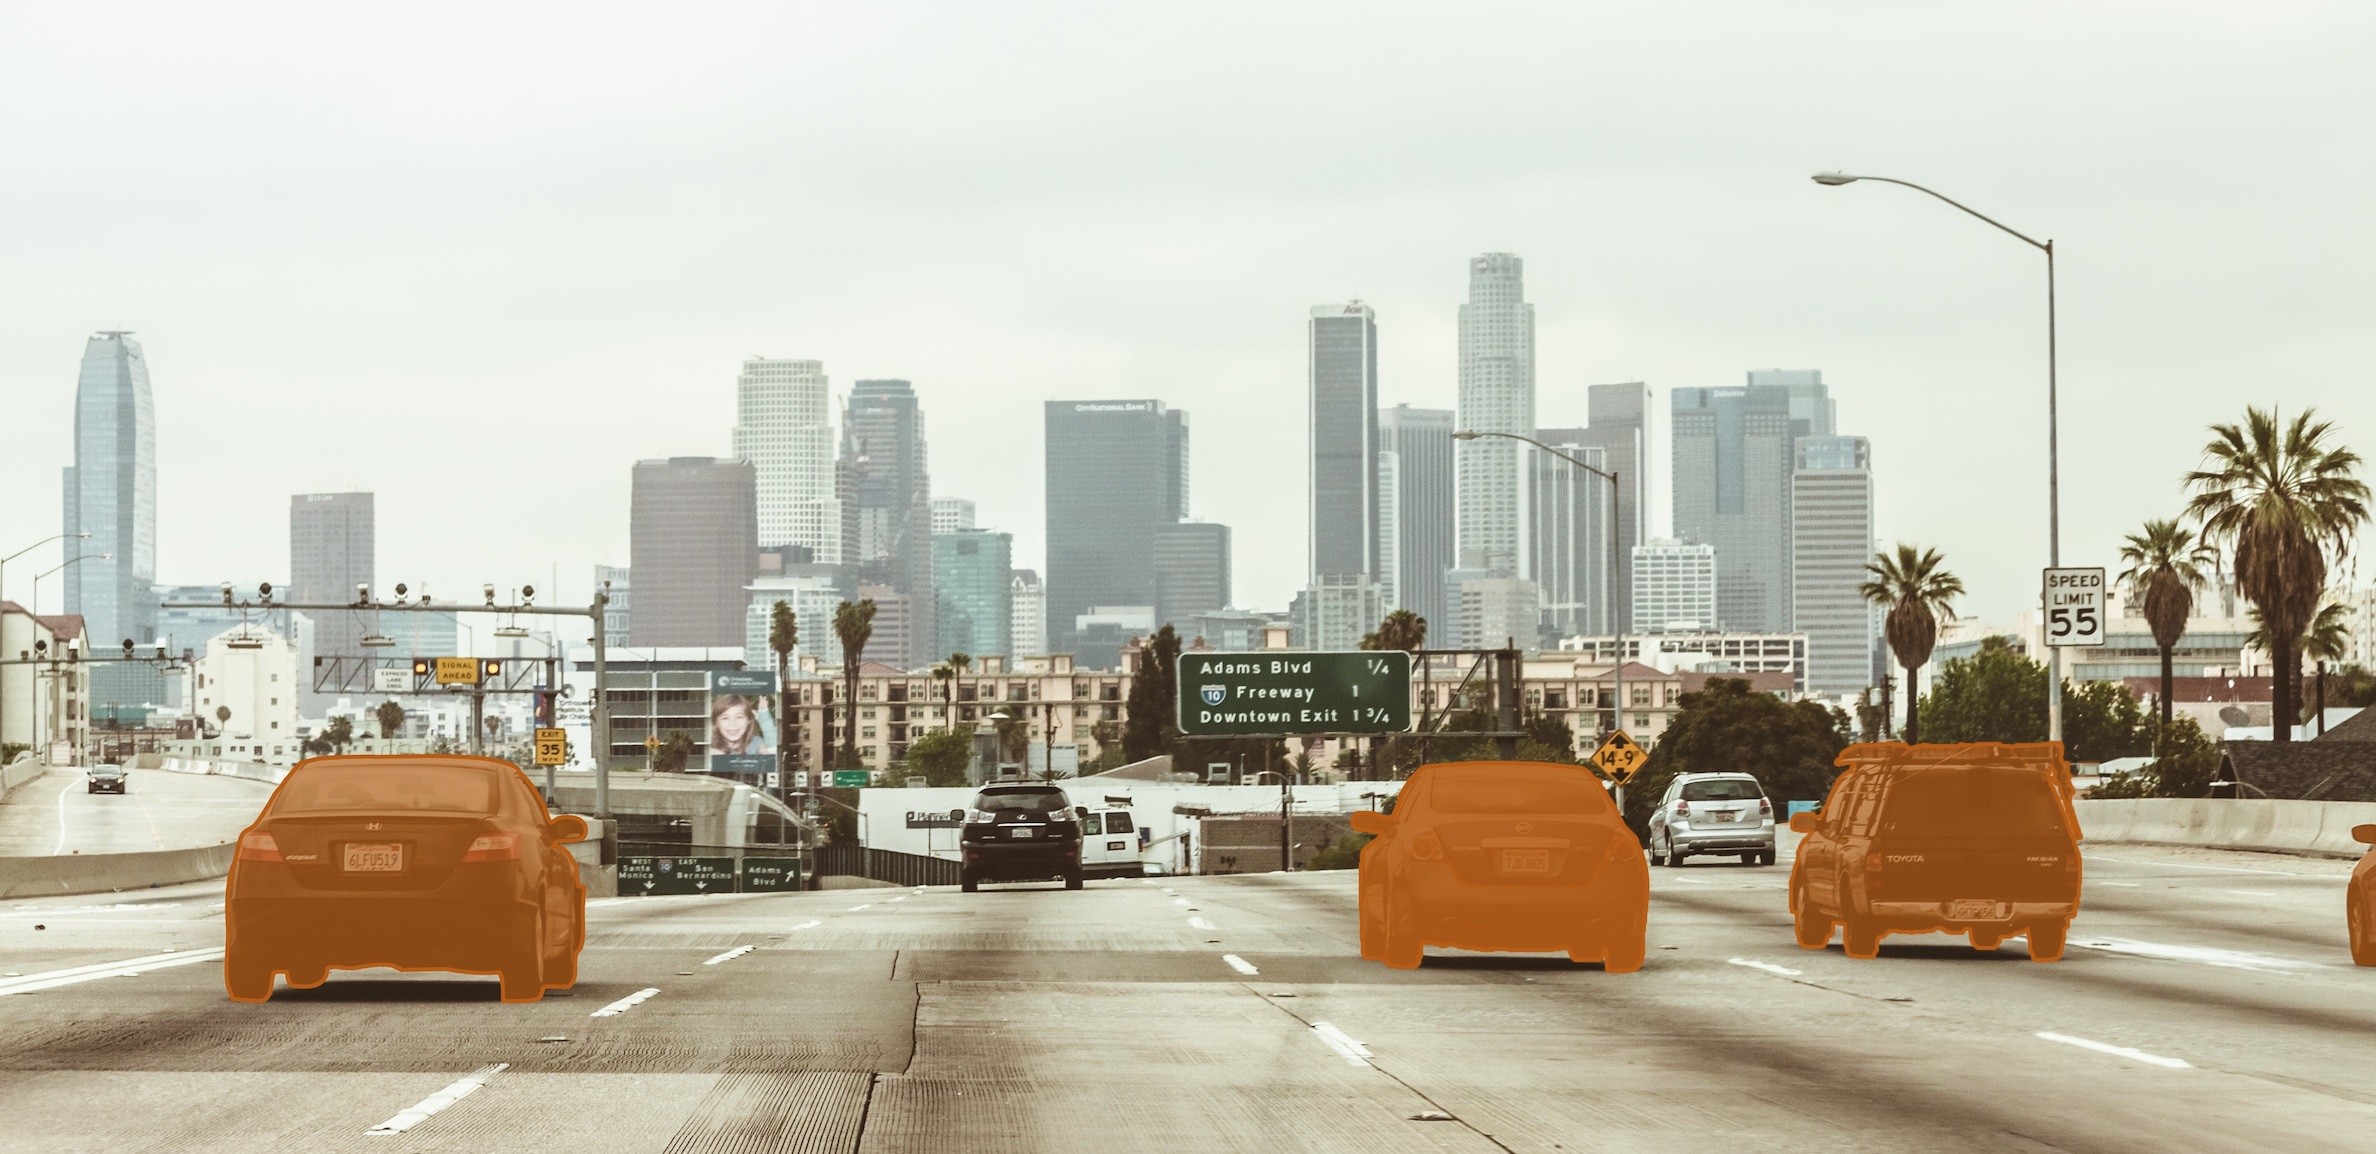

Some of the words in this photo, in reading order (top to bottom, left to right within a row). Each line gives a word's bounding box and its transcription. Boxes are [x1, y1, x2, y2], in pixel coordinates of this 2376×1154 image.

[2048, 573, 2101, 588] SPEED
[2053, 592, 2095, 605] LIMIT
[2049, 607, 2098, 637] 55
[441, 661, 473, 669] SIGNAL
[1199, 660, 1262, 675] Adams
[1270, 660, 1312, 675] Blvd
[442, 672, 472, 680] AHEAD
[1207, 690, 1221, 701] 10
[1235, 685, 1315, 703] Freeway
[1352, 684, 1359, 698] 1
[1199, 709, 1292, 724] Downtown
[1300, 708, 1338, 722] Exit
[1352, 709, 1359, 722] 1
[541, 744, 560, 756] 35
[348, 853, 399, 867] 6LFU519
[1886, 855, 1925, 863] TOYOTA
[622, 864, 651, 872] Santa
[660, 863, 671, 871] 10
[694, 864, 714, 872] San
[748, 866, 782, 874] Adams
[676, 871, 733, 880] Bernardino
[752, 877, 776, 886] Blvd
